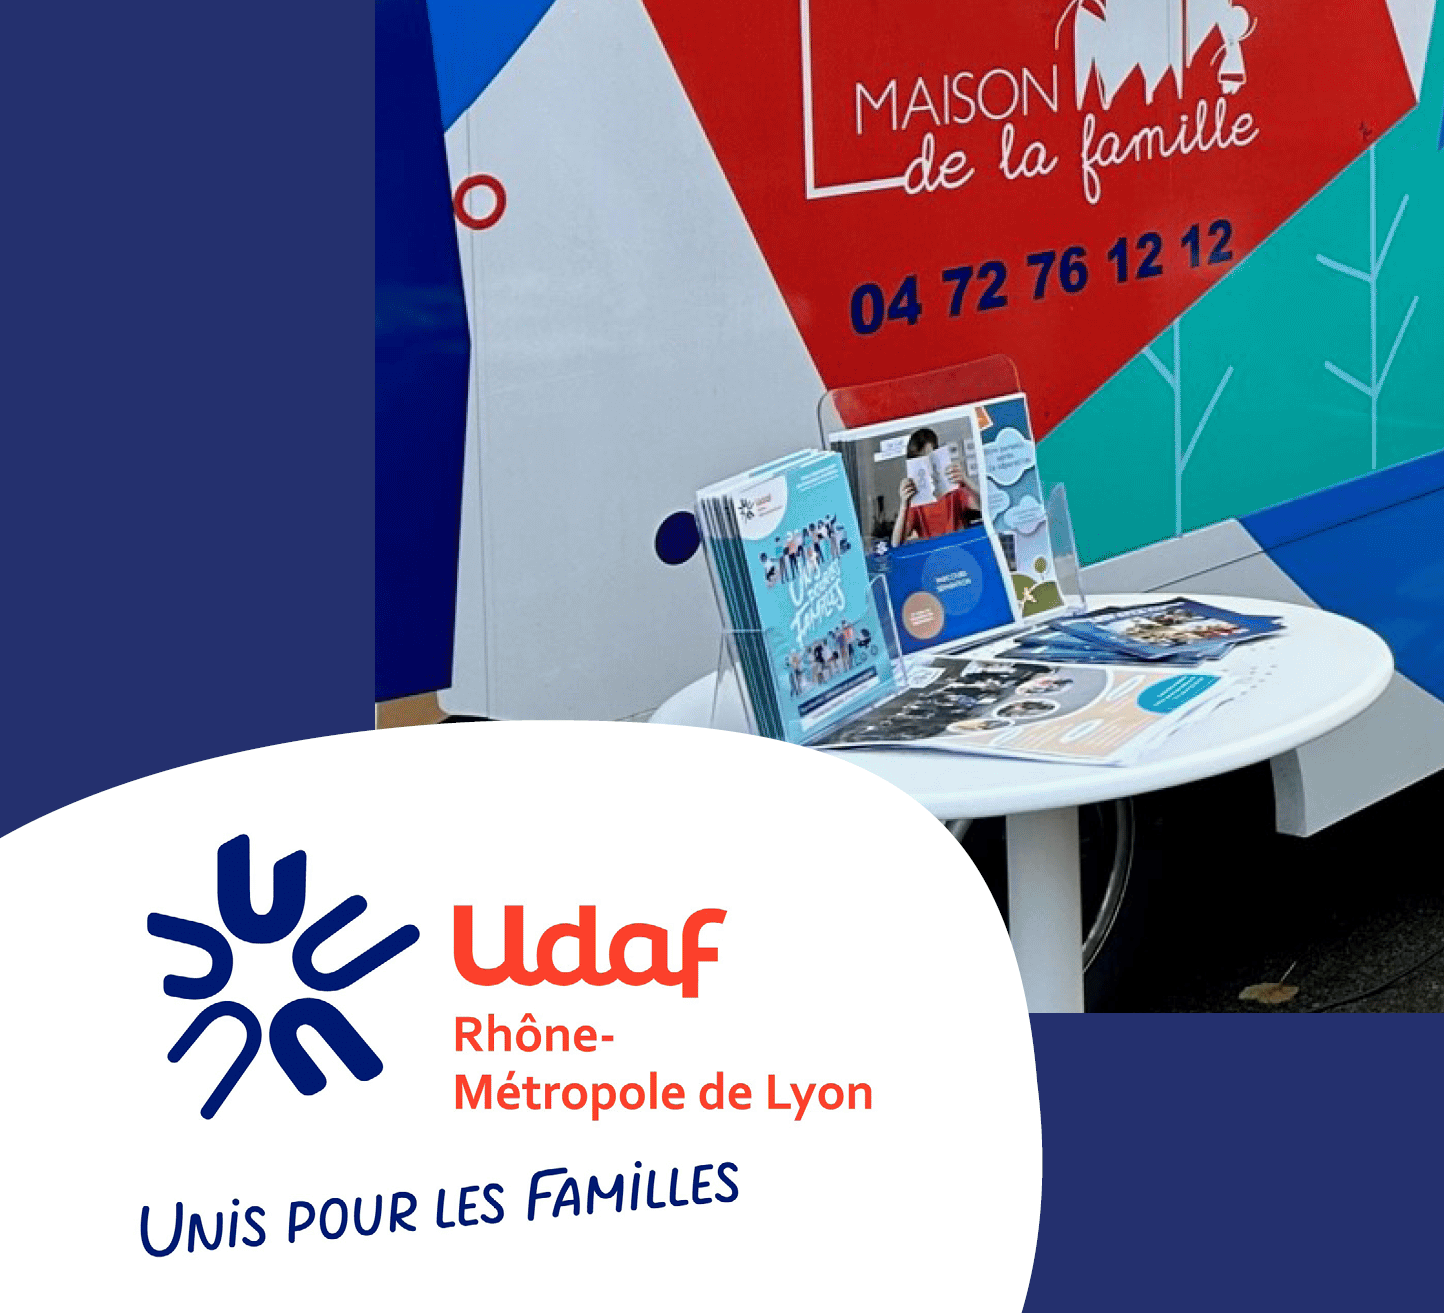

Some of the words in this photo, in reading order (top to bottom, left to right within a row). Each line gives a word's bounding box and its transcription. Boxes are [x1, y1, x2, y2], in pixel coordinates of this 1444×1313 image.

[855, 64, 1059, 135] MAISON
[904, 133, 975, 194] de
[999, 124, 1058, 181] la
[1082, 97, 1260, 205] famille
[849, 275, 923, 335] 04
[941, 261, 1008, 317] 72
[1027, 246, 1089, 299] 76
[1107, 232, 1163, 282] 12
[1181, 219, 1234, 268] 12
